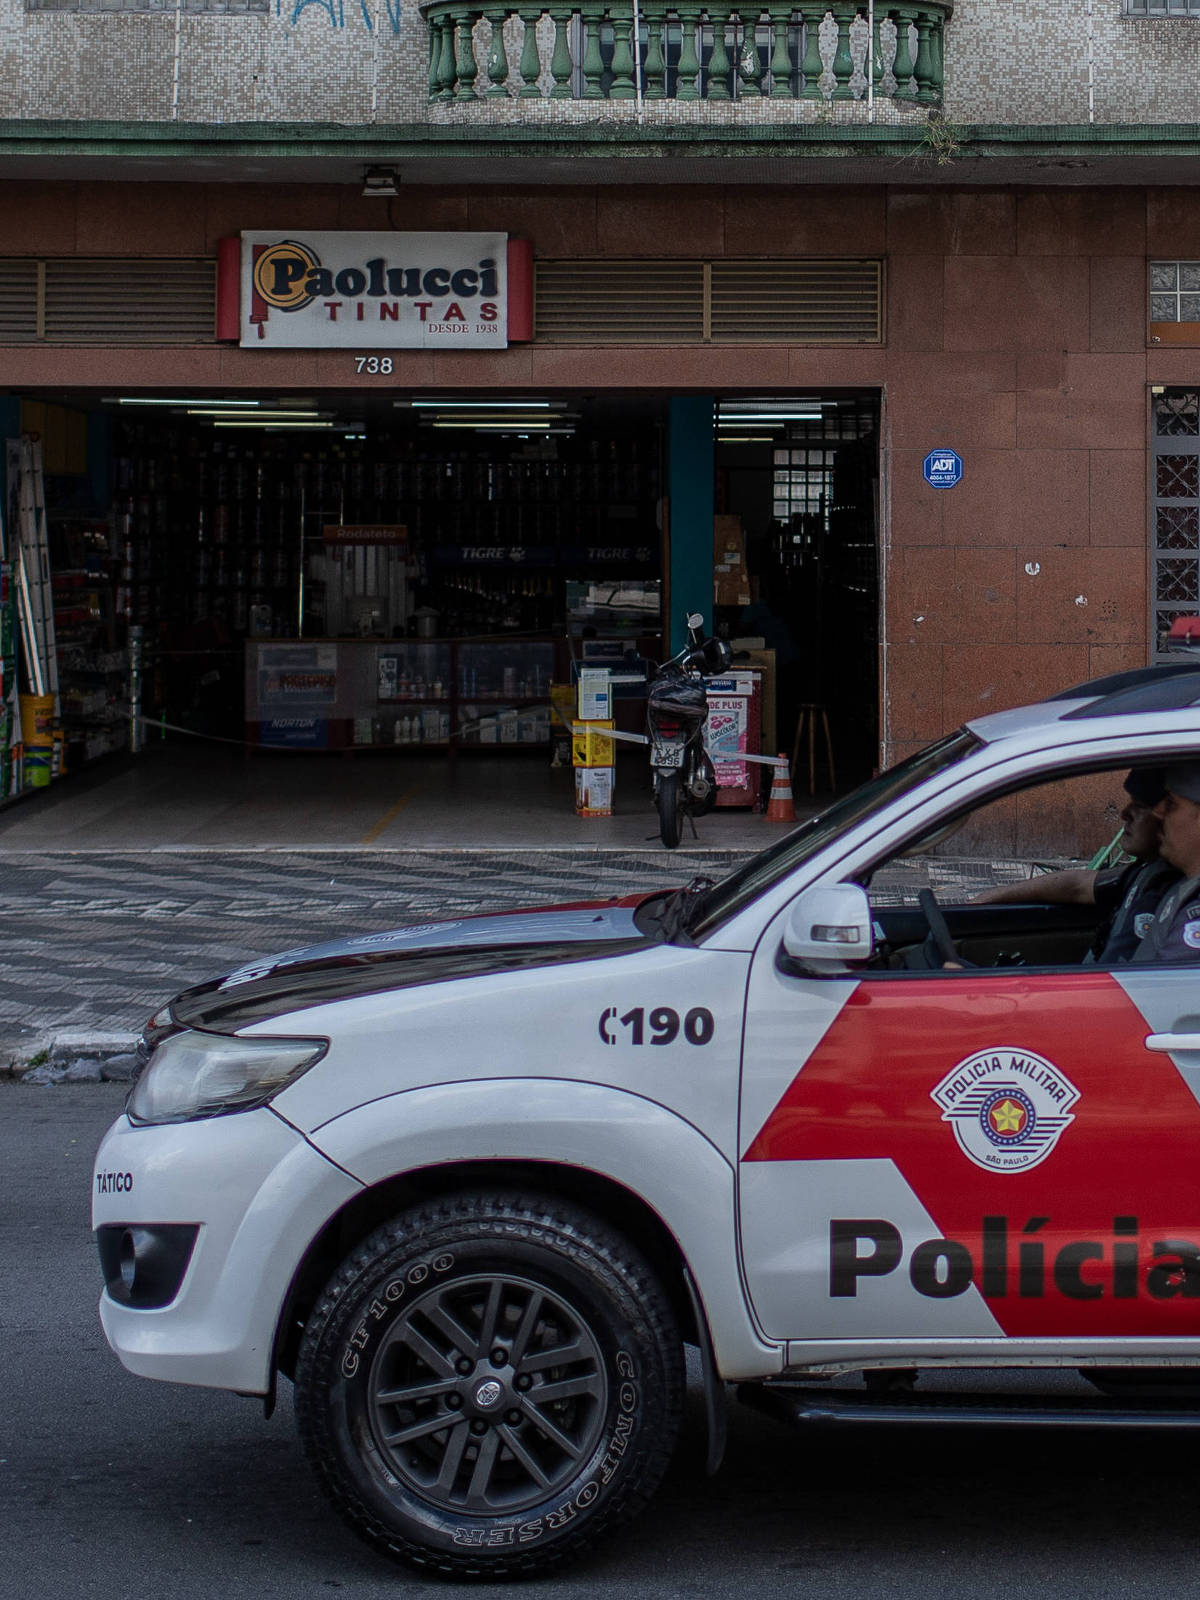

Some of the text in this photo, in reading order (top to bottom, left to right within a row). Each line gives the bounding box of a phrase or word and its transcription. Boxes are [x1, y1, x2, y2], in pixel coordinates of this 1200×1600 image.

[270, 257, 498, 297] Paolucci
[324, 302, 498, 321] TINTAS
[428, 324, 498, 334] DESDE 1938
[355, 357, 393, 374] 738
[932, 458, 955, 471] ADT
[461, 547, 506, 560] TIGRE
[587, 547, 633, 560] TIGRE
[272, 719, 315, 729] NORTON
[620, 1006, 714, 1046] 190
[1009, 1056, 1067, 1103] MILITAR
[985, 1154, 1029, 1165] SÃO PAULO
[453, 1349, 637, 1547] COMFORSER
